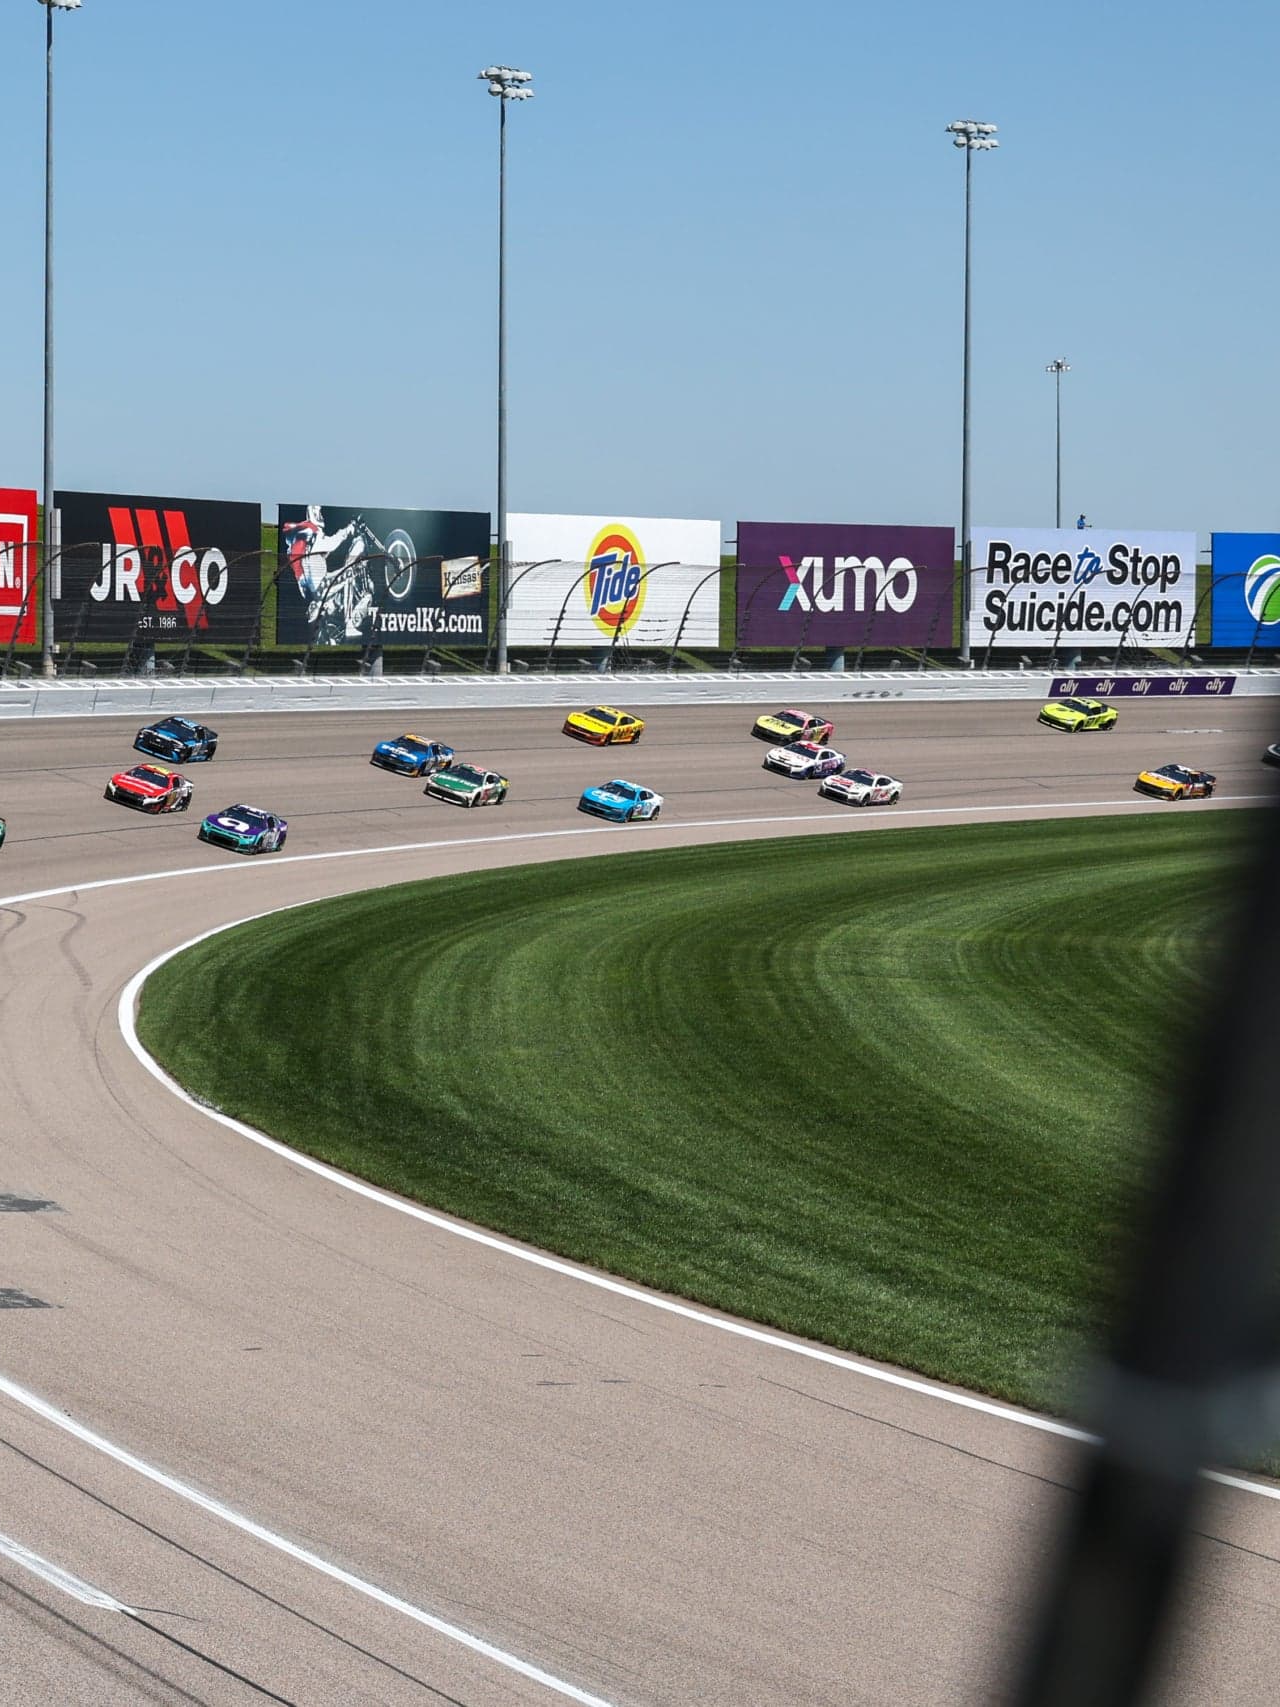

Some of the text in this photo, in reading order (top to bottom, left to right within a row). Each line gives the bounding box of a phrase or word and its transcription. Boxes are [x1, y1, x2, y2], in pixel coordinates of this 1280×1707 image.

[987, 542, 1181, 594] Race to Stop
[590, 553, 641, 616] Tide
[777, 556, 918, 613] xumo
[983, 589, 1182, 633] Suicide.com
[159, 616, 177, 629] 1986
[1060, 679, 1079, 696] ally
[1096, 679, 1116, 695] ally
[1132, 678, 1151, 695] ally
[1169, 678, 1188, 694] ally
[1206, 677, 1225, 694] ally
